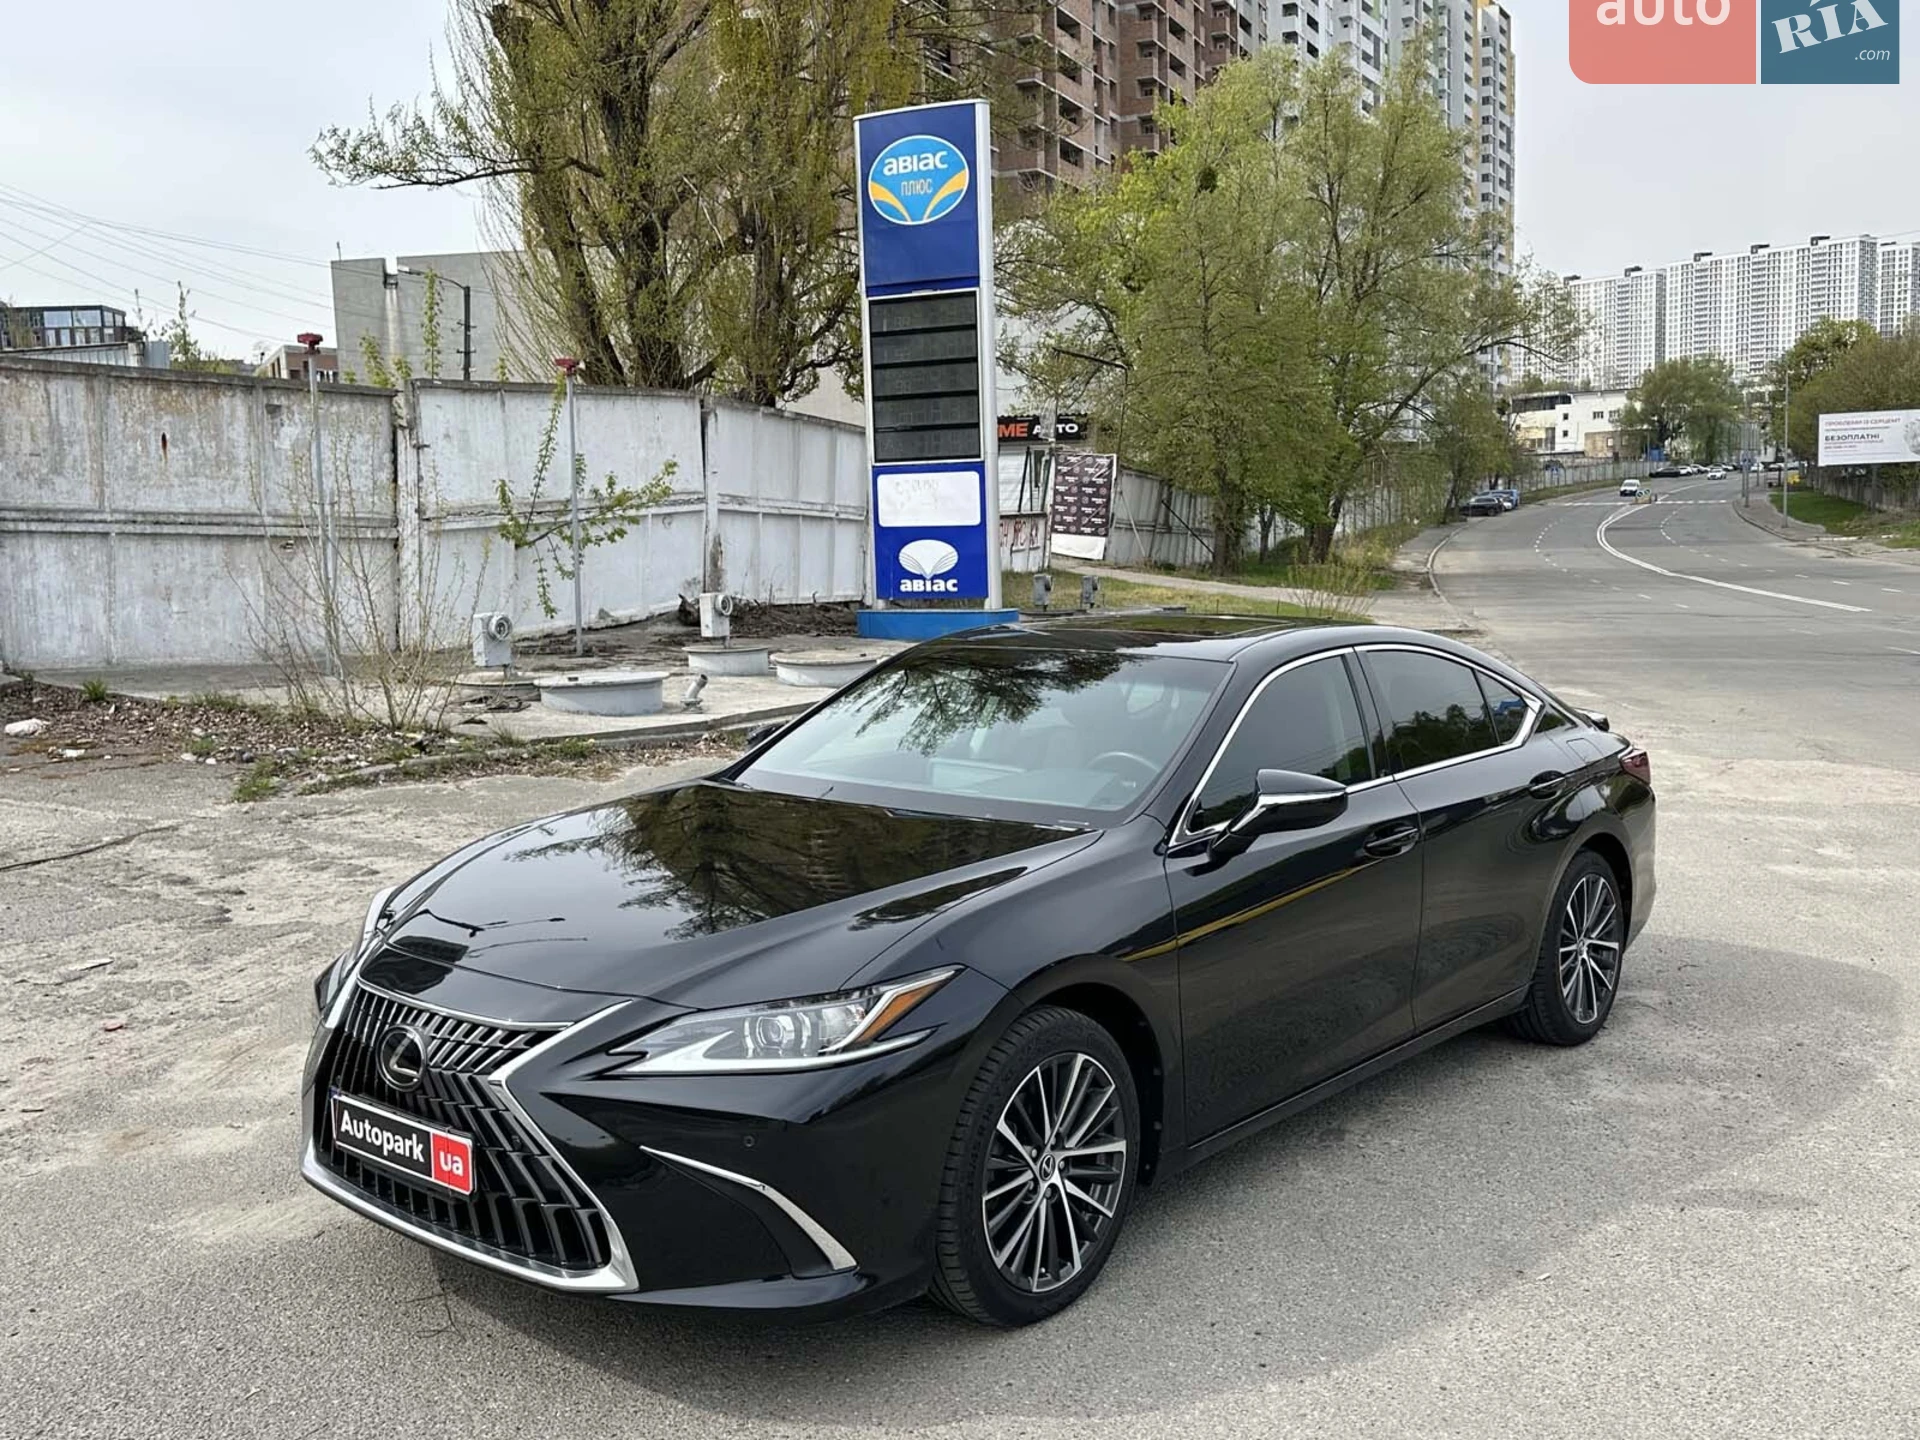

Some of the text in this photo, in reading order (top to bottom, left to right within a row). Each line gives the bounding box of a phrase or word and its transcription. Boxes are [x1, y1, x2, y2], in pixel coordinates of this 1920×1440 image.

[901, 179, 933, 196] ПЛЮС
[1032, 423, 1079, 435] ATO
[340, 1110, 464, 1177] Autopark ua
